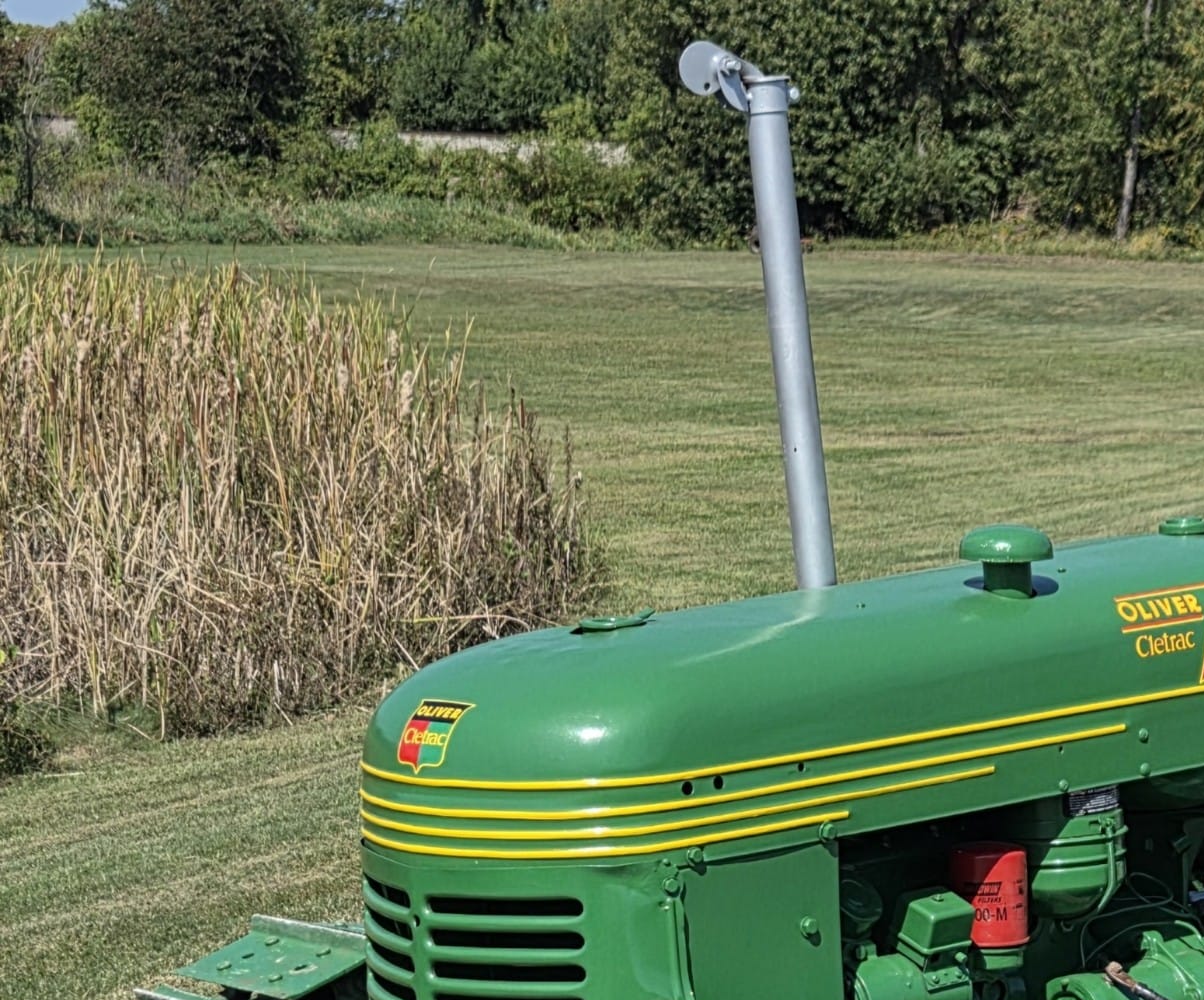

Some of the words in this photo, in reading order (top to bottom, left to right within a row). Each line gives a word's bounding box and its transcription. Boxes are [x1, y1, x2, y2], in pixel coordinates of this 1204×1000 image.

[1117, 594, 1202, 622] OLIVER
[1135, 631, 1195, 658] Cletrac
[417, 705, 462, 719] OLIVER
[404, 727, 448, 746] Cletrac
